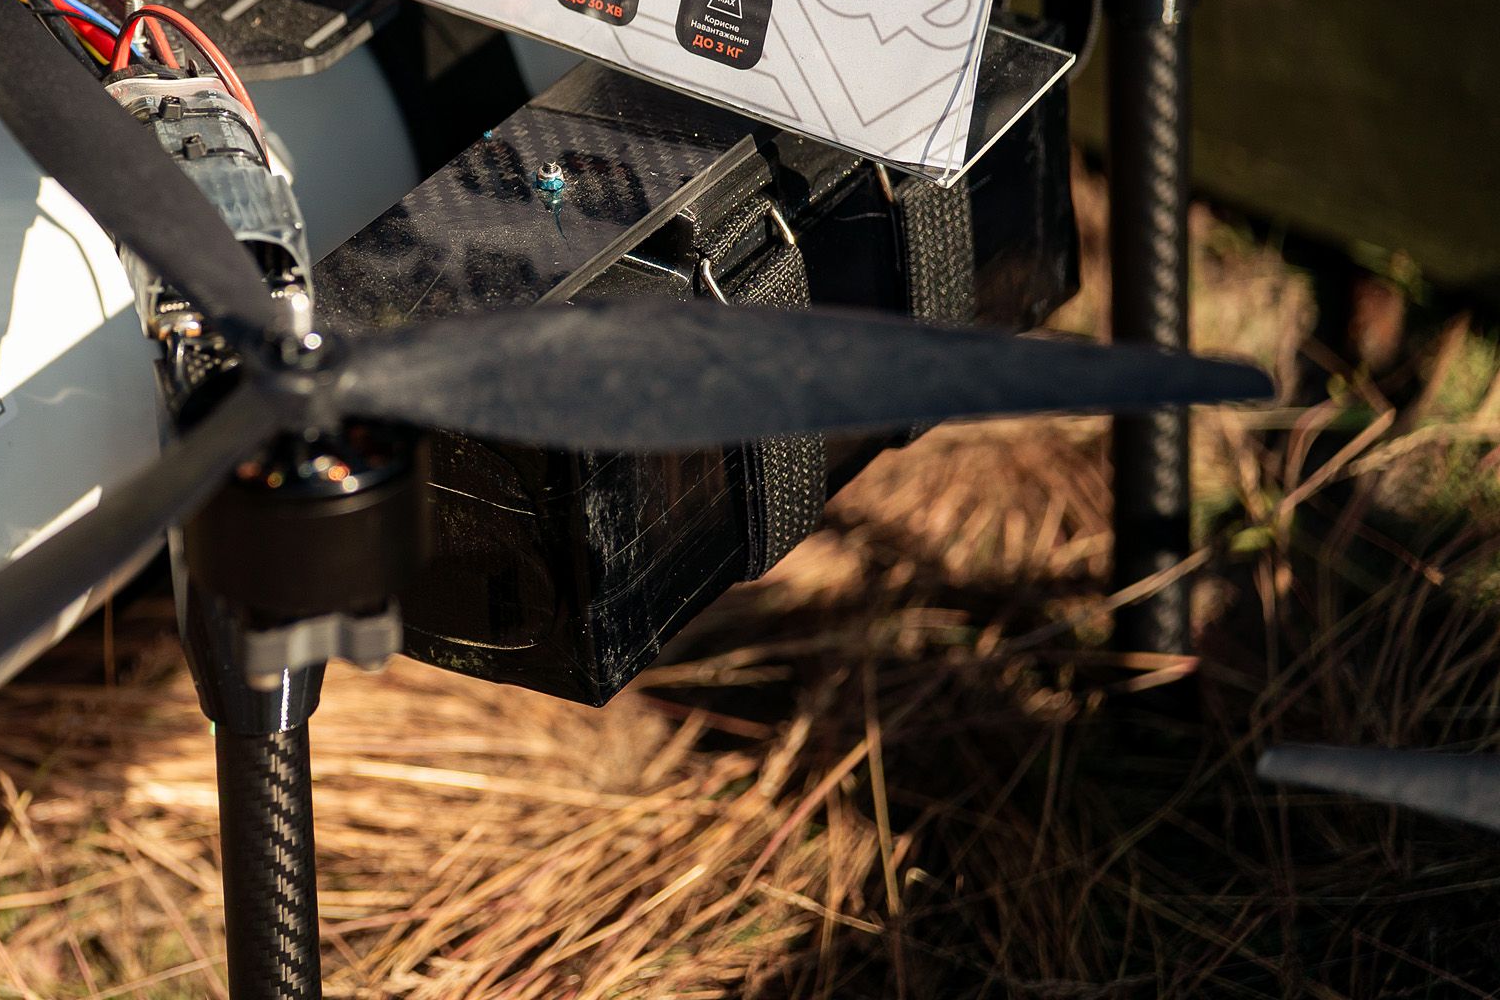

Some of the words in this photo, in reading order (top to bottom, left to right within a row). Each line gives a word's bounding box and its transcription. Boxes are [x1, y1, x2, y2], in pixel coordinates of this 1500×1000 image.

[605, 2, 624, 19] ХВ
[690, 19, 750, 46] Навантаження
[704, 14, 740, 33] Корисне
[692, 34, 715, 50] ДО
[716, 41, 725, 54] 3
[726, 45, 744, 59] КГ
